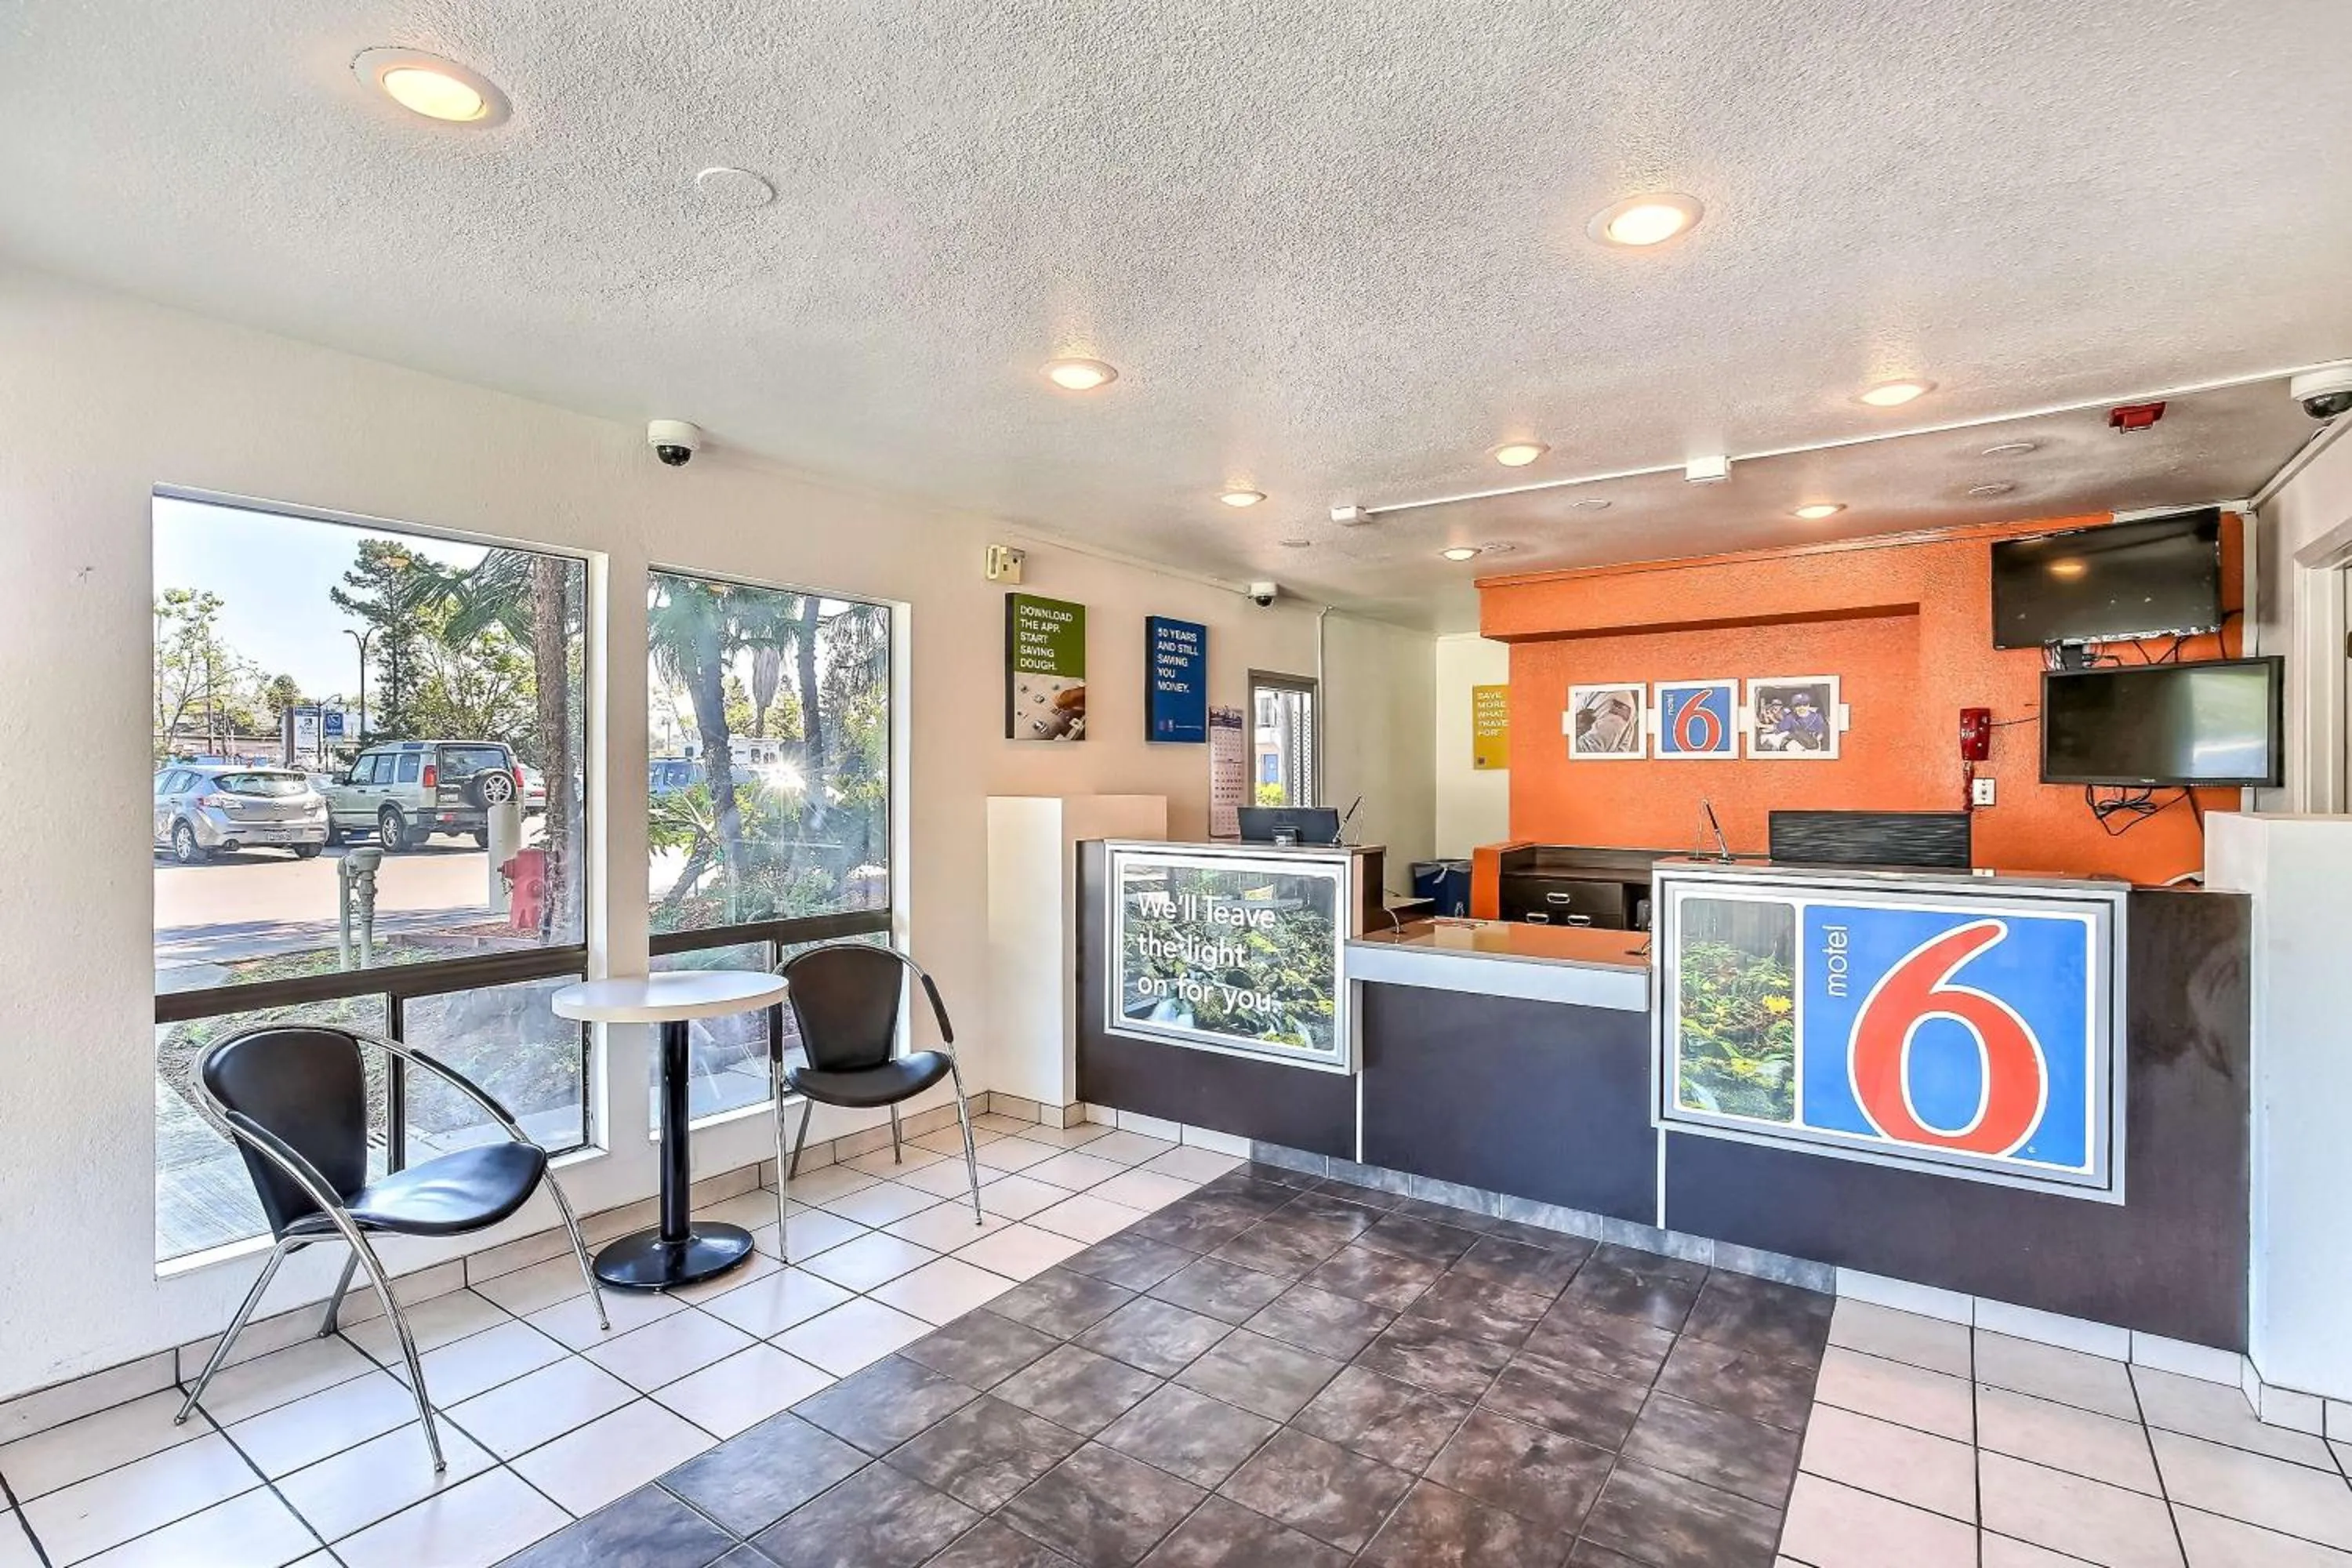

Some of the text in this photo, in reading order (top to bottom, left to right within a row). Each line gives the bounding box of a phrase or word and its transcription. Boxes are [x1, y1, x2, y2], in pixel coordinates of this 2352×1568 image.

[1020, 605, 1073, 622] DOWNLOAD
[1021, 619, 1060, 633] THE APP.
[1020, 631, 1047, 643] START
[1158, 627, 1197, 642] 50 YEARS
[1020, 644, 1054, 658] SAVING
[1157, 641, 1198, 655] AND STILL
[1020, 658, 1058, 670] DOUGH.
[1157, 653, 1189, 667] SAVING
[1157, 666, 1175, 678] YOU
[1158, 680, 1189, 693] MONEY.
[1673, 690, 1722, 753] 6
[1138, 892, 1196, 920] We'll
[1137, 930, 1247, 971] the light
[1138, 972, 1279, 1014] on for you.
[1822, 918, 2048, 1159] motel 6
